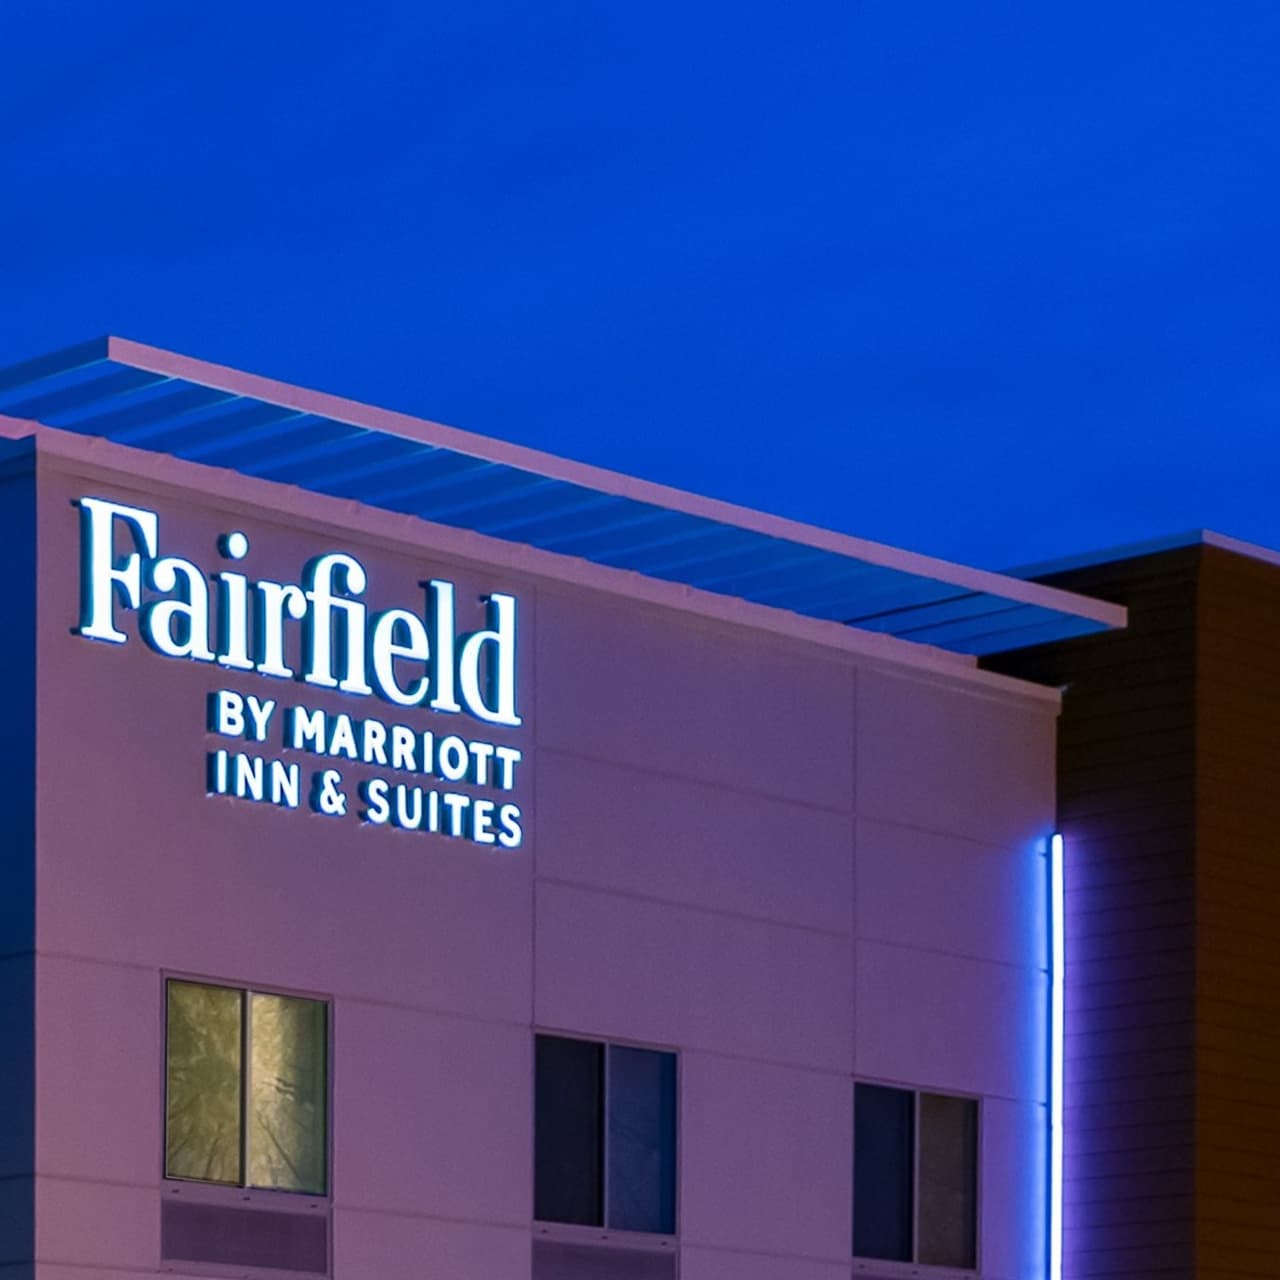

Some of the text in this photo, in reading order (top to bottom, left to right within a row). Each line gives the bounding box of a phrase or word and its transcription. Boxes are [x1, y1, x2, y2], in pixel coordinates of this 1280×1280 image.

[75, 497, 521, 726] Fairfield
[216, 690, 521, 790] BY MARRIOTT
[214, 750, 522, 849] INN & SUITES
